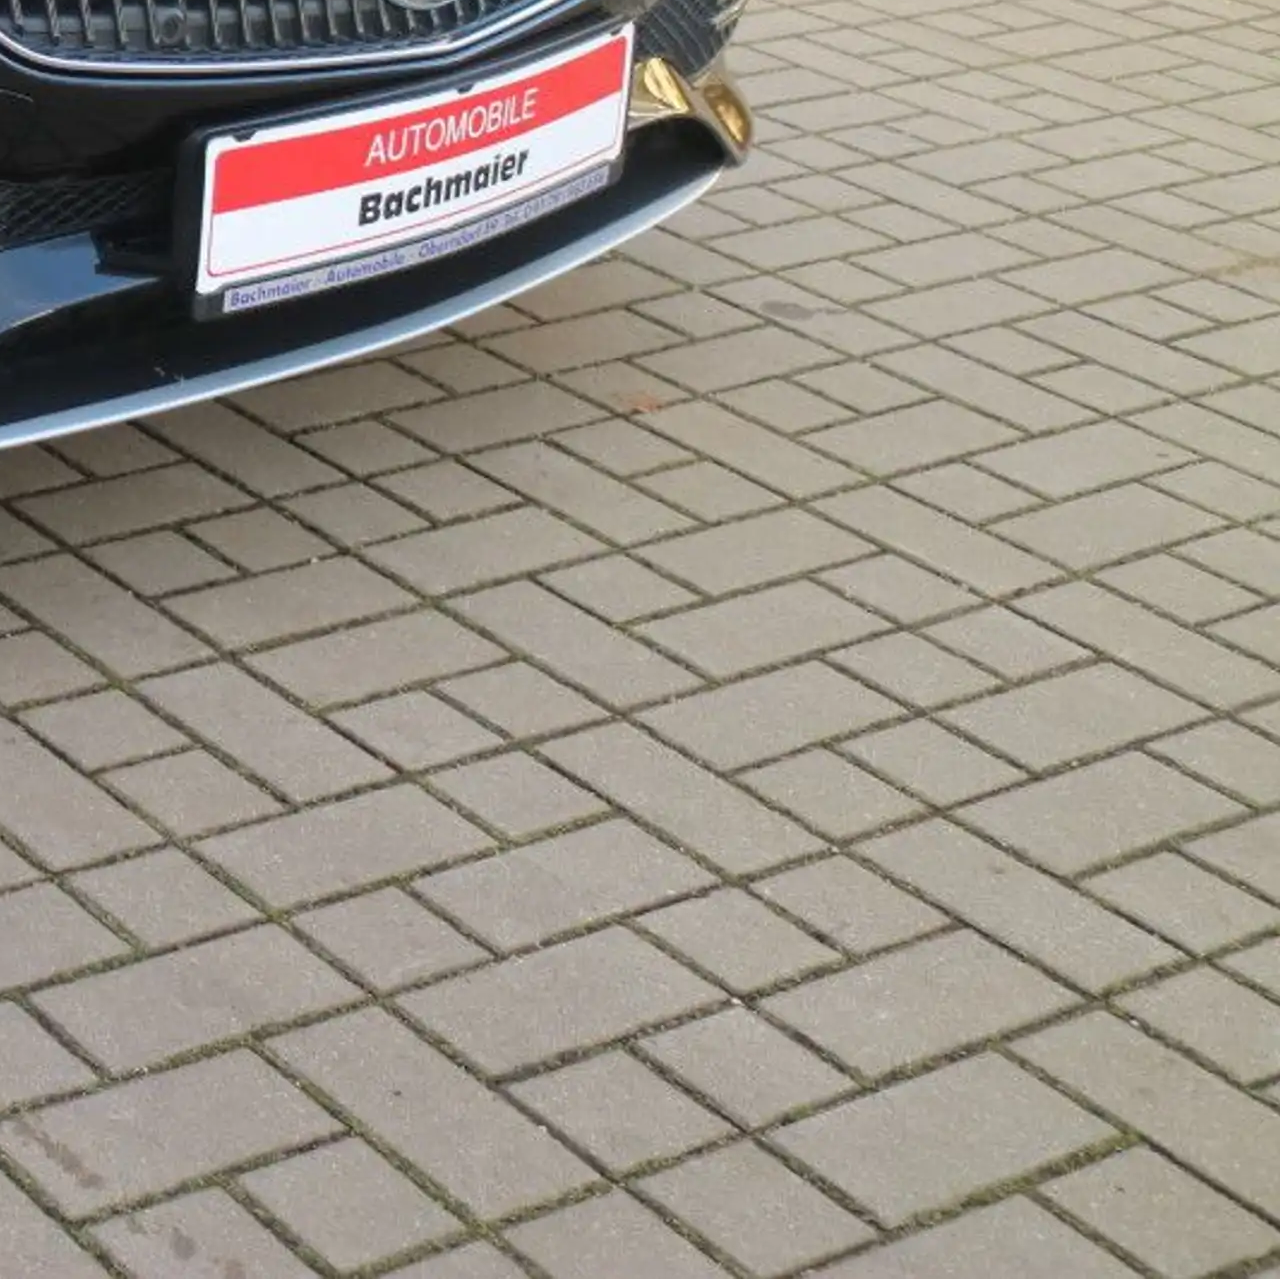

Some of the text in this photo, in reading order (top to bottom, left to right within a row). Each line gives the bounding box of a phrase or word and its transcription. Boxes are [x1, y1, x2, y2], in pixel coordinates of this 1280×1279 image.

[364, 87, 539, 167] AUTOMOBILE
[358, 149, 529, 226] Bachmaier
[230, 278, 311, 308] Bachmaier
[325, 252, 406, 284] Automobile
